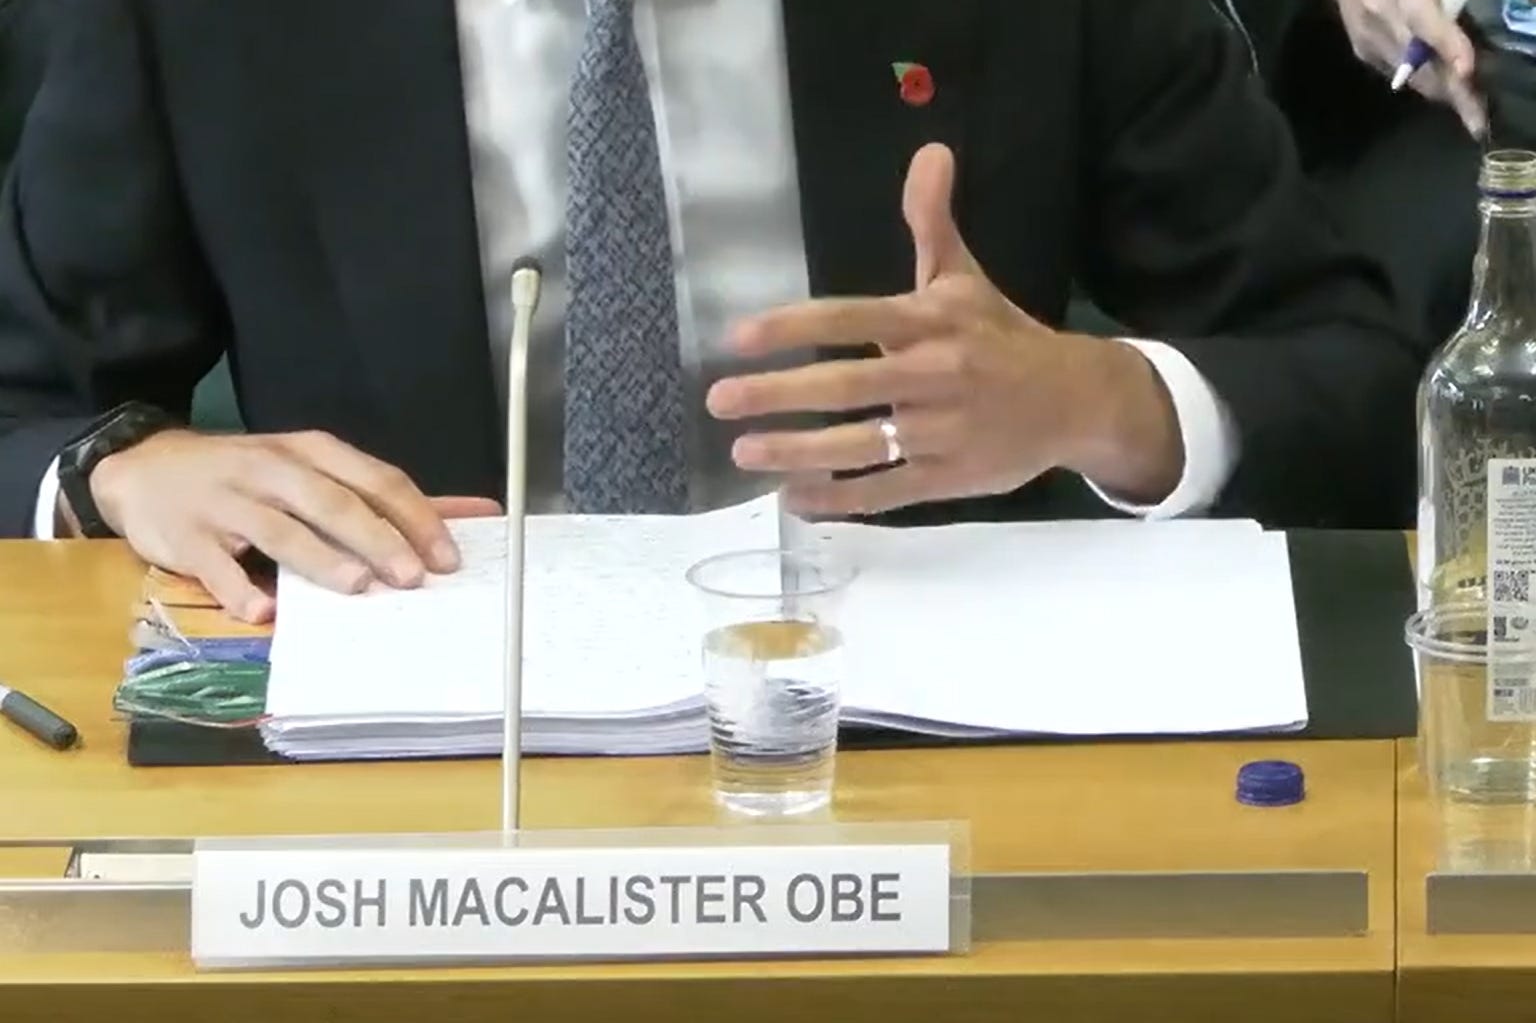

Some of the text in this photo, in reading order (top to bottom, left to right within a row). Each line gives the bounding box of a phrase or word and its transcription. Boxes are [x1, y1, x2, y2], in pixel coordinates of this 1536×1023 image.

[239, 873, 902, 928] JOSH MACALISTER OBE
